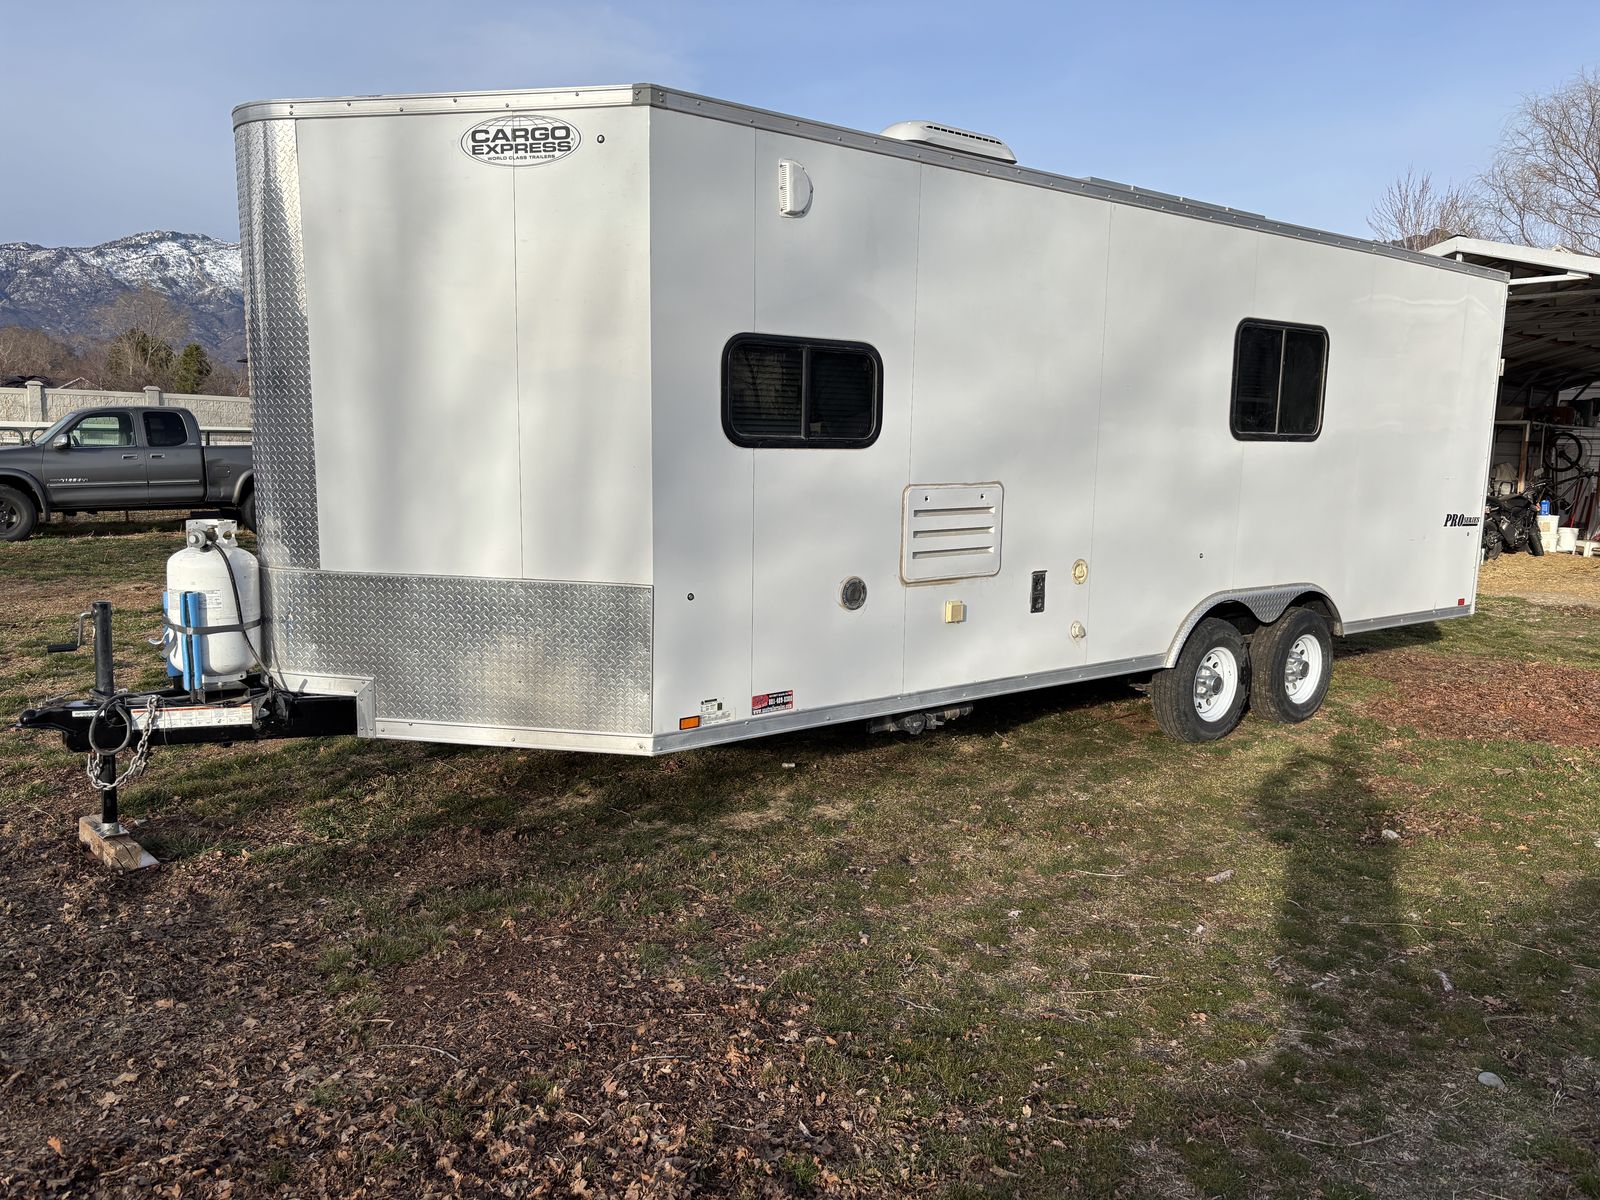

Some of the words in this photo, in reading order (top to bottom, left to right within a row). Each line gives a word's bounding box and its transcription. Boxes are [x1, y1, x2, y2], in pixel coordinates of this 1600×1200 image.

[471, 126, 571, 143] CARGO
[471, 141, 572, 155] EXPRESS
[1444, 513, 1464, 526] PRO
